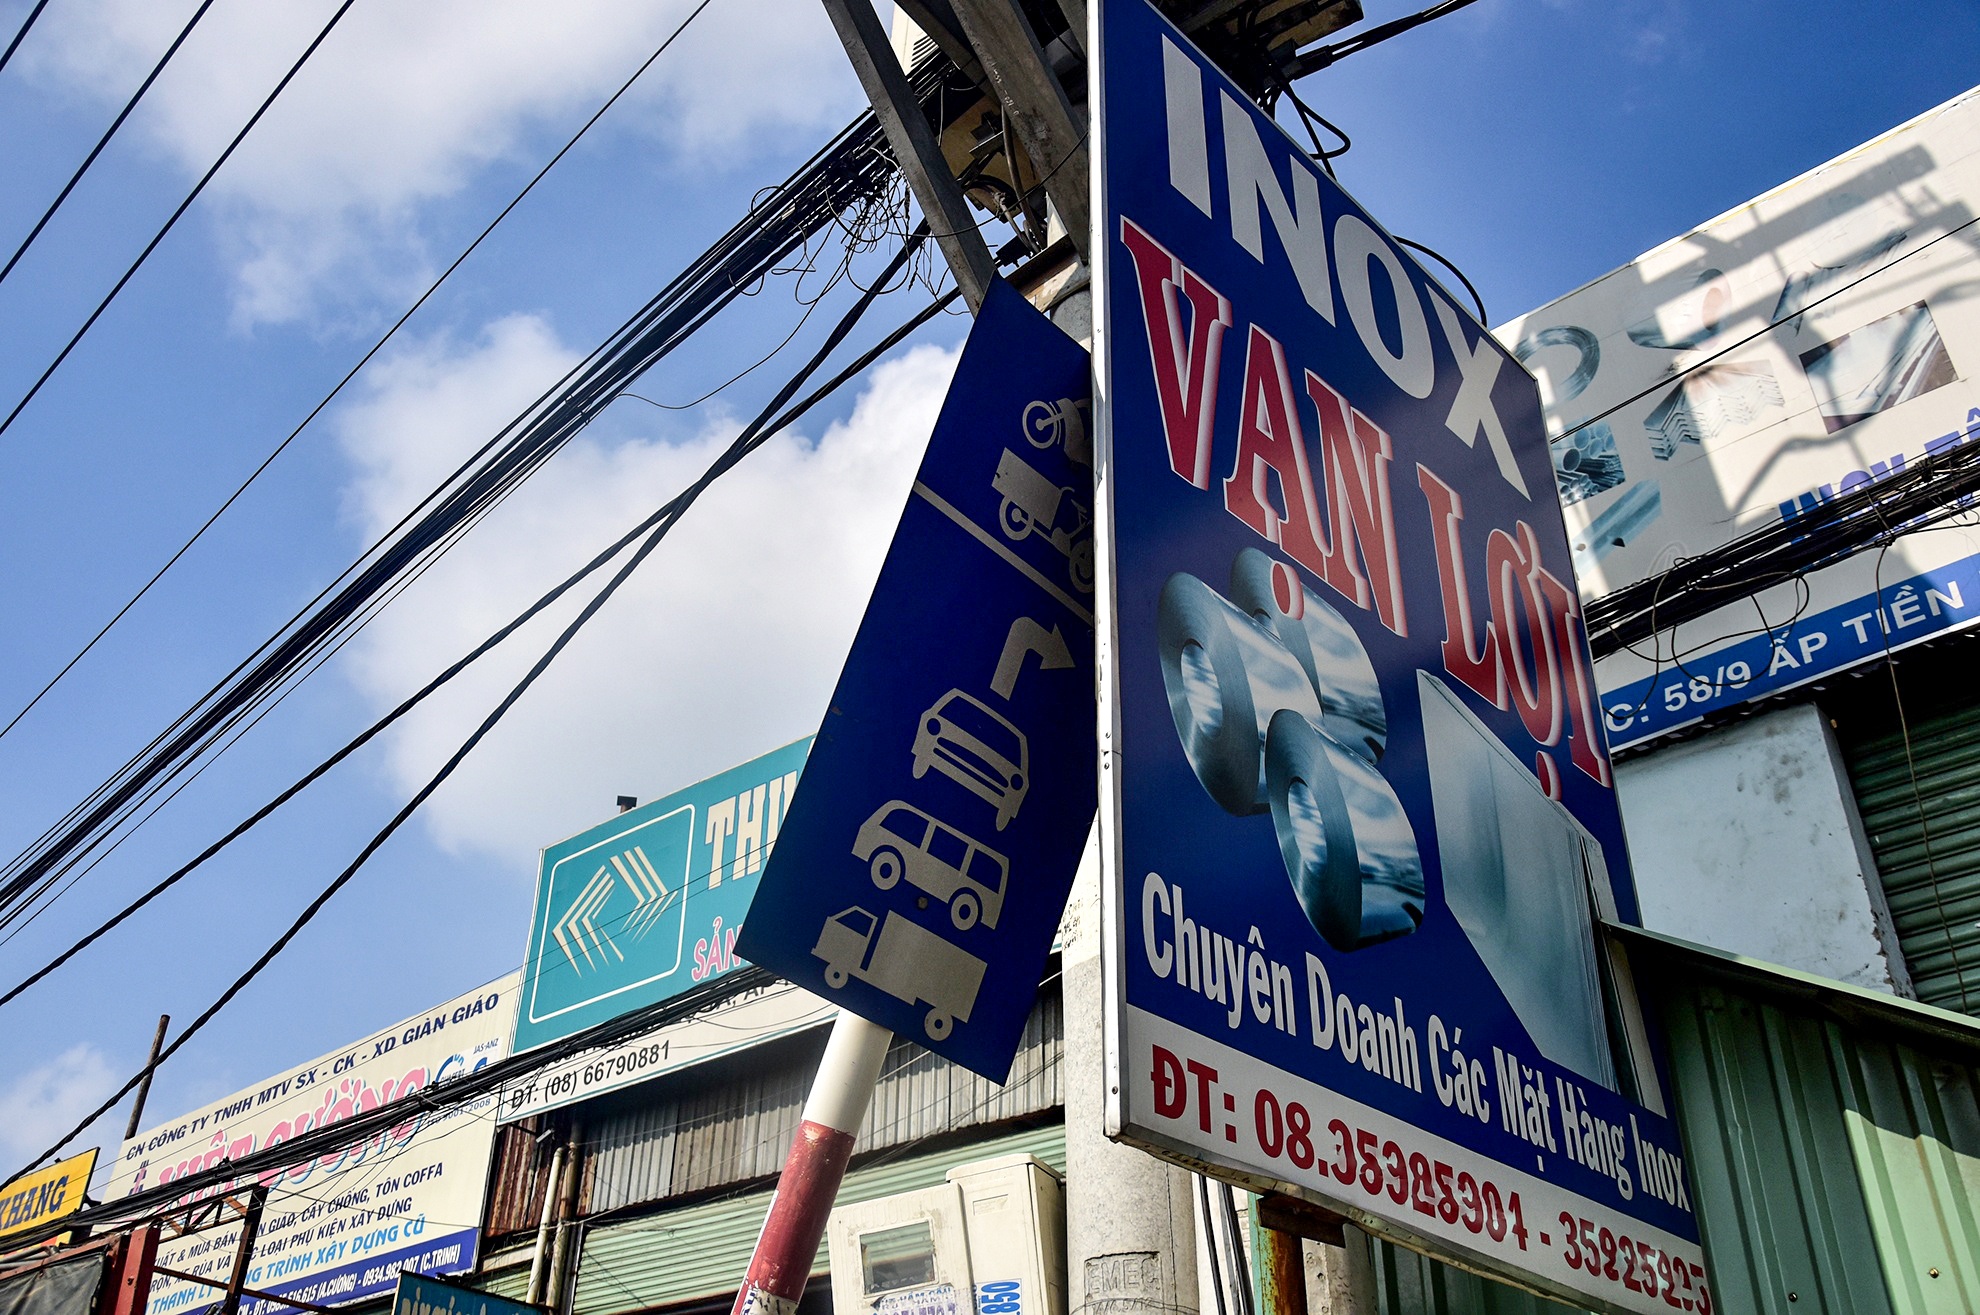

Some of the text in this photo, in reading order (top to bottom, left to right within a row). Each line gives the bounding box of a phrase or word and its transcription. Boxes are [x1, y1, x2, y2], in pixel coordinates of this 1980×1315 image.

[1162, 33, 1532, 502] INOX
[1120, 215, 1408, 638] VẠN
[1417, 462, 1612, 801] LỢI
[1605, 580, 1965, 732] C: 58/9 ẤP TIỀN
[127, 1142, 145, 1160] CN
[149, 1125, 186, 1151] CÔNG
[192, 1115, 209, 1133] TY
[214, 1096, 253, 1124] TNHH
[257, 1078, 291, 1106] MTV
[296, 1069, 317, 1089] SX
[333, 1053, 357, 1074] CK
[372, 1036, 396, 1059] XD
[402, 1014, 446, 1045] GIÀN
[452, 993, 499, 1024] GIÁO
[545, 1071, 577, 1103] (08)
[583, 1039, 670, 1085] 66790881
[1141, 872, 1296, 1036] Chuyên
[1306, 951, 1422, 1094] Doanh
[1427, 1014, 1491, 1125] Các
[1492, 1046, 1557, 1173] Mặt
[1559, 1076, 1632, 1200] Hàng
[1634, 1114, 1692, 1214] Inox
[1150, 1043, 1238, 1144] ĐT:
[152, 1286, 197, 1314] THANH
[267, 1250, 314, 1280] TRÌNH
[314, 1239, 349, 1265] XÂY
[351, 1224, 399, 1255] DỰNG
[403, 1213, 426, 1238] CŨ
[188, 1240, 211, 1260] MUA
[213, 1231, 237, 1250] BÁN
[302, 1202, 324, 1223] CÂY
[375, 1177, 399, 1198] TÔN
[403, 1162, 443, 1188] COFFA
[260, 1238, 288, 1259] LOẠI
[290, 1231, 313, 1253] PHỤ
[317, 1217, 344, 1242] KIỆN
[349, 1209, 375, 1229] XÂY
[378, 1196, 412, 1220] DỰNG
